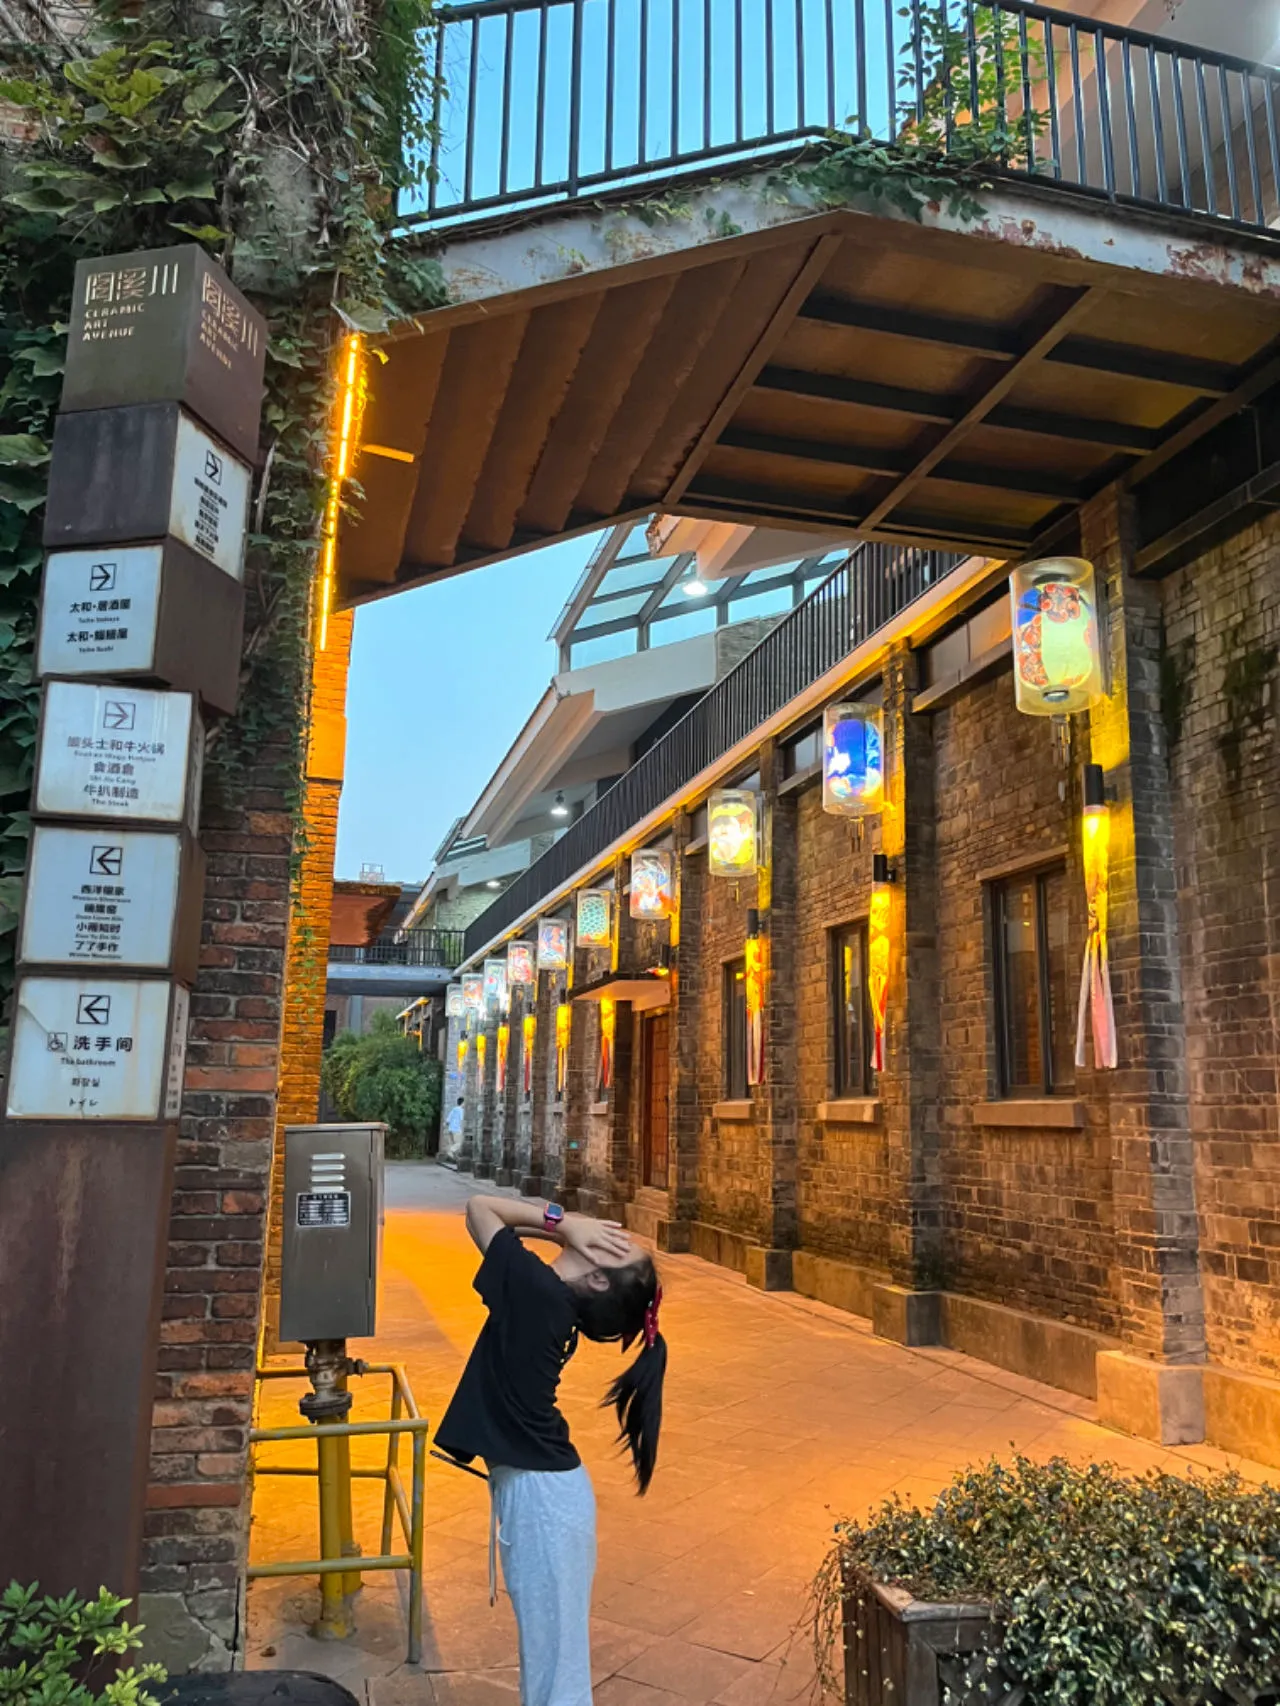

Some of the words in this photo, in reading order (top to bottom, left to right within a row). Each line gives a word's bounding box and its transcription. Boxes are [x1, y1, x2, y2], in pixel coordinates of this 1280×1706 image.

[84, 319, 108, 331] ART
[82, 327, 135, 341] AVENUE
[72, 1035, 133, 1053] 洗手间
